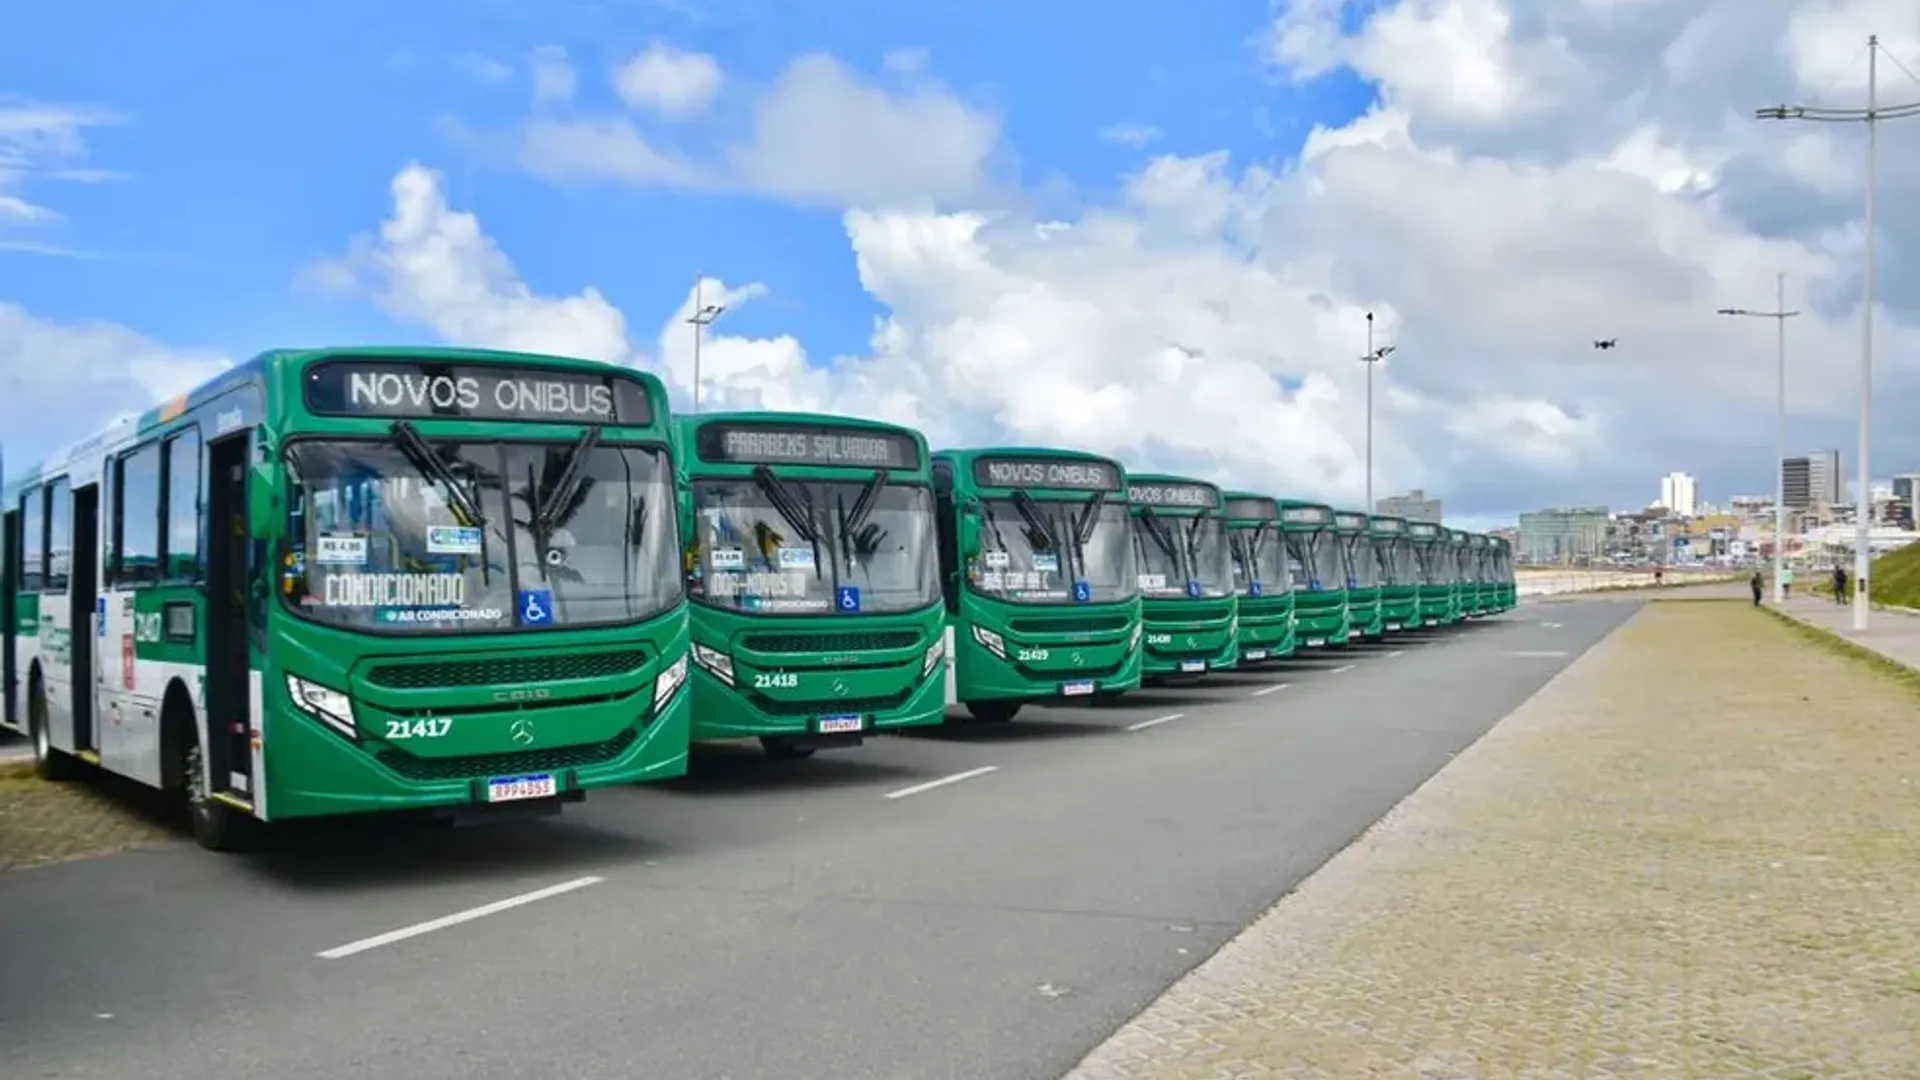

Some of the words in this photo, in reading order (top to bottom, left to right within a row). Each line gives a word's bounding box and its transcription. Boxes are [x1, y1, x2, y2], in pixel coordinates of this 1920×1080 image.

[351, 372, 480, 409] NOVOS
[495, 379, 612, 414] ONIBUS
[813, 434, 888, 461] SALVADOR
[988, 463, 1043, 482] NOVOS
[1047, 464, 1102, 484] ONIBUS
[1129, 485, 1161, 502] OVOS
[325, 572, 465, 606] CONDICIONADO
[398, 610, 415, 622] AR
[417, 608, 502, 622] CONDICIONADO
[754, 673, 798, 689] 21418
[385, 718, 452, 739] 21417
